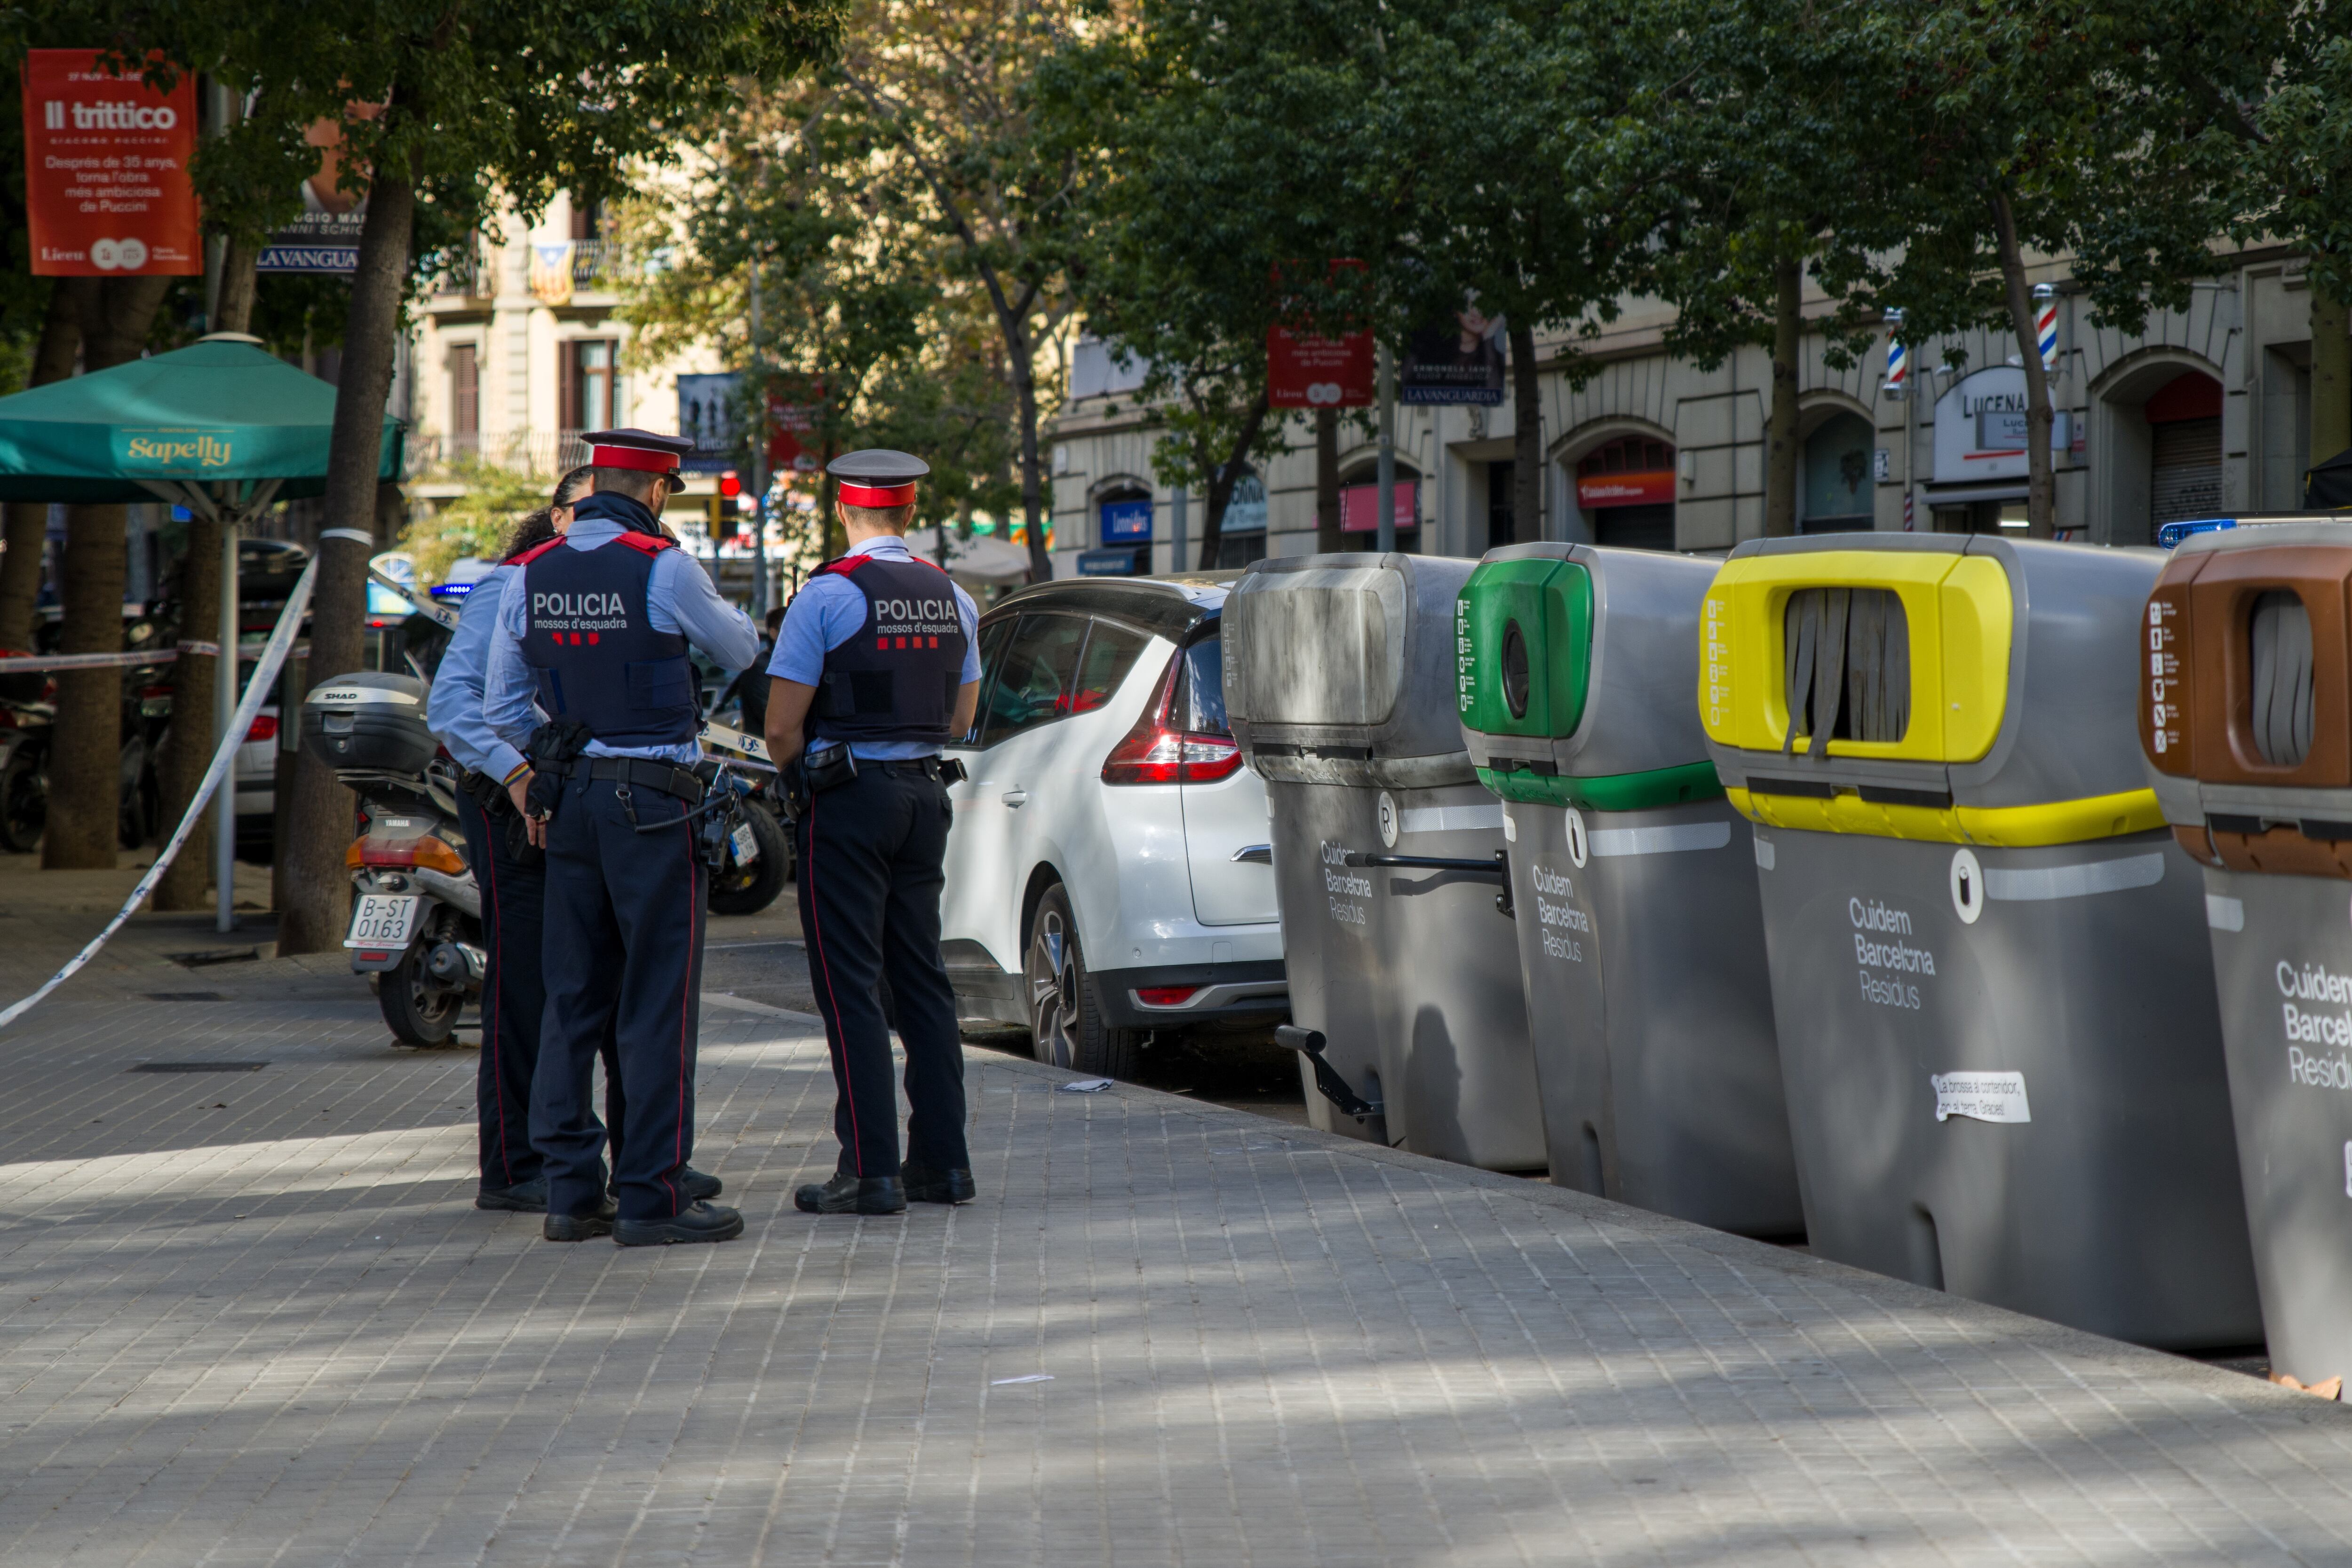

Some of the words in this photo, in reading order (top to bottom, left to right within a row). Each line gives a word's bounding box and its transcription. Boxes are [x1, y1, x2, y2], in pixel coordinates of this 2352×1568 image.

[45, 100, 66, 130] Il
[71, 100, 178, 130] trittico
[46, 156, 101, 170] Després
[103, 156, 120, 168] de
[76, 172, 110, 182] torna
[65, 187, 93, 198] més
[95, 186, 162, 198] ambiciosa
[79, 201, 97, 212] de
[100, 199, 147, 212] Puccini
[1963, 393, 2025, 418] LUCENA
[128, 436, 230, 466] Sapelly
[533, 593, 626, 616] POLICIA
[874, 599, 958, 621] POLICIA
[534, 619, 569, 629] mossos
[571, 618, 628, 631] d'esquadra
[877, 625, 913, 634] mossos
[914, 622, 958, 635] d'esquadra
[1382, 807, 1392, 834] R
[1325, 868, 1372, 898] Barcelona
[1533, 865, 1573, 898] Cuidem
[363, 898, 412, 917] B-ST
[1329, 896, 1366, 924] Residus
[1538, 896, 1589, 933] Barcelona
[1850, 897, 1912, 935] Cuidem
[358, 919, 404, 938] 0163
[1542, 928, 1582, 962] Residus
[1854, 934, 1936, 975] Barcelona
[1859, 970, 1921, 1009] Residus
[1938, 1079, 1947, 1093] La
[1949, 1078, 1973, 1093] brossa
[1974, 1078, 1979, 1093] al
[1981, 1079, 2021, 1096] contenidor,
